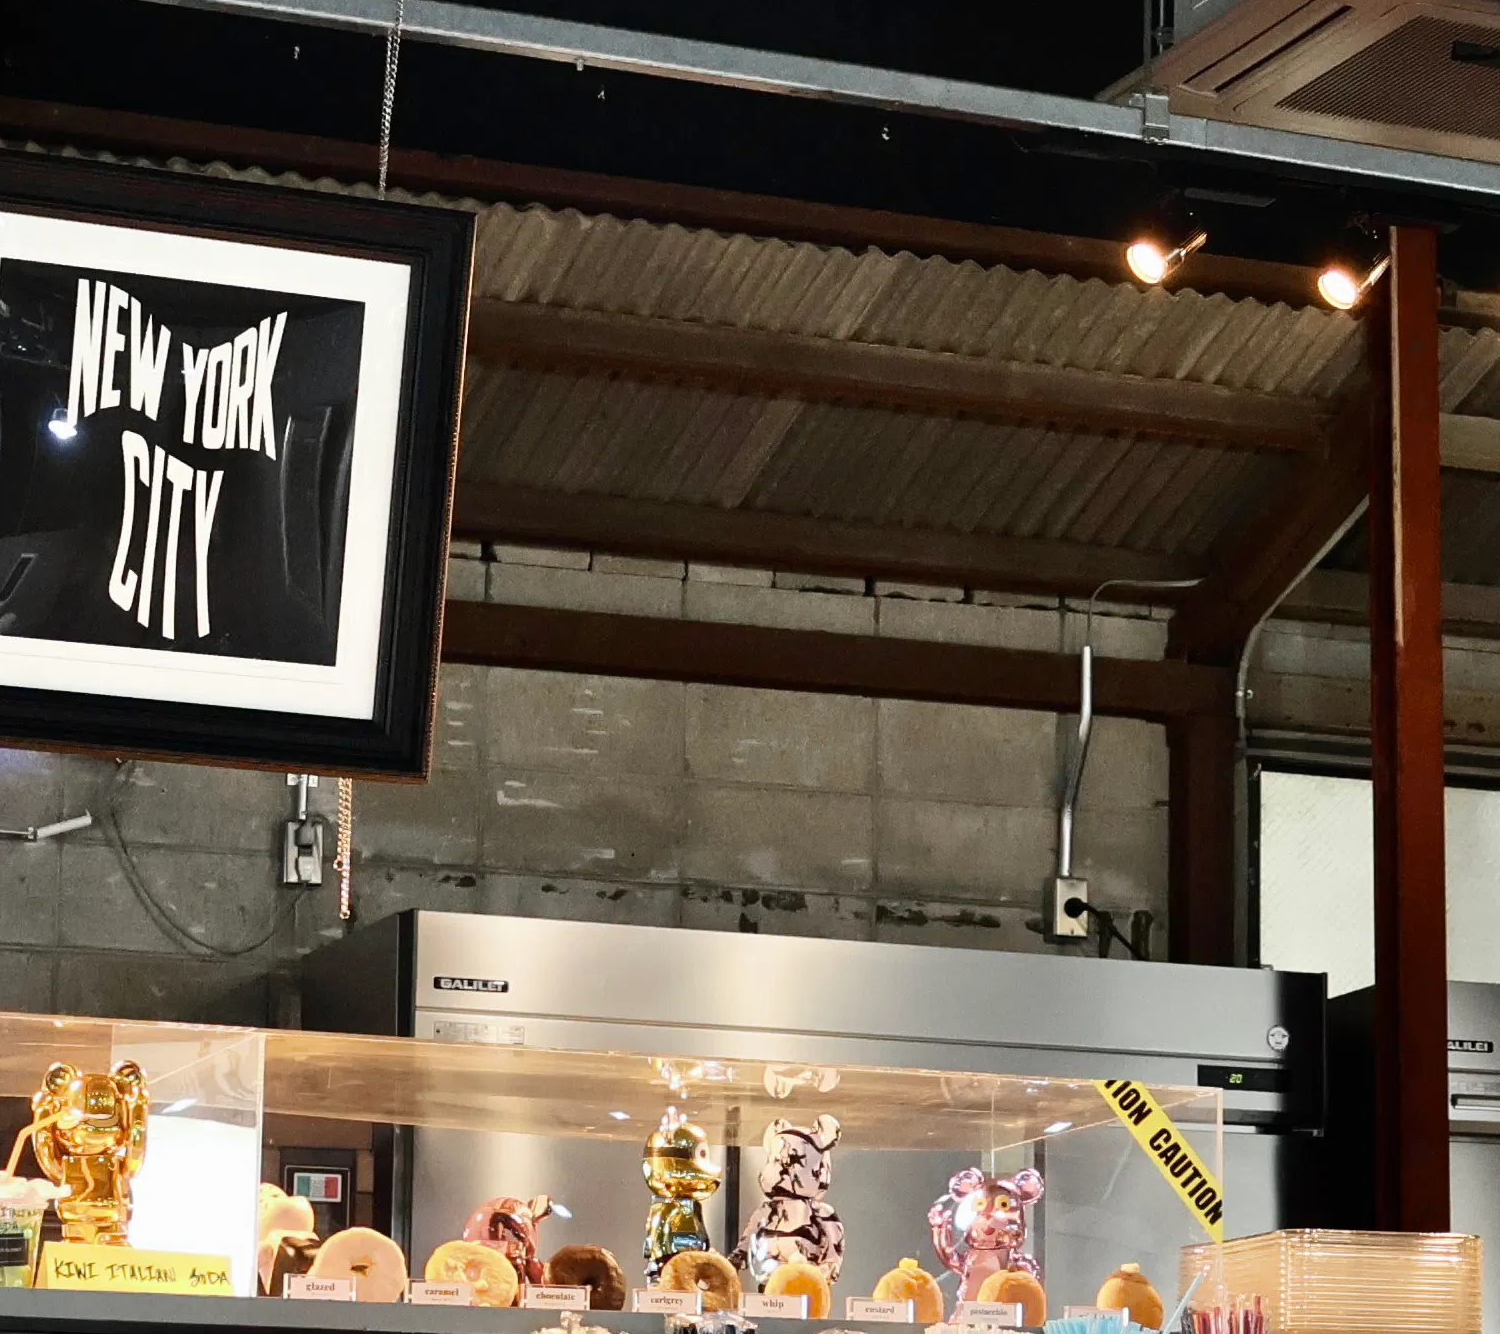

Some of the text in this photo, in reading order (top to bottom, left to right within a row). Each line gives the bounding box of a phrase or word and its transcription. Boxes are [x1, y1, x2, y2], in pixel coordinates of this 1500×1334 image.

[68, 278, 287, 461] NEW YORK
[108, 430, 224, 640] CITY
[1447, 1041, 1489, 1052] ALILEI
[1149, 1128, 1223, 1226] CAUTION
[53, 1259, 231, 1286] KIWI ITALIAN SODA
[424, 1287, 460, 1297] caramel
[762, 1299, 785, 1310] whip
